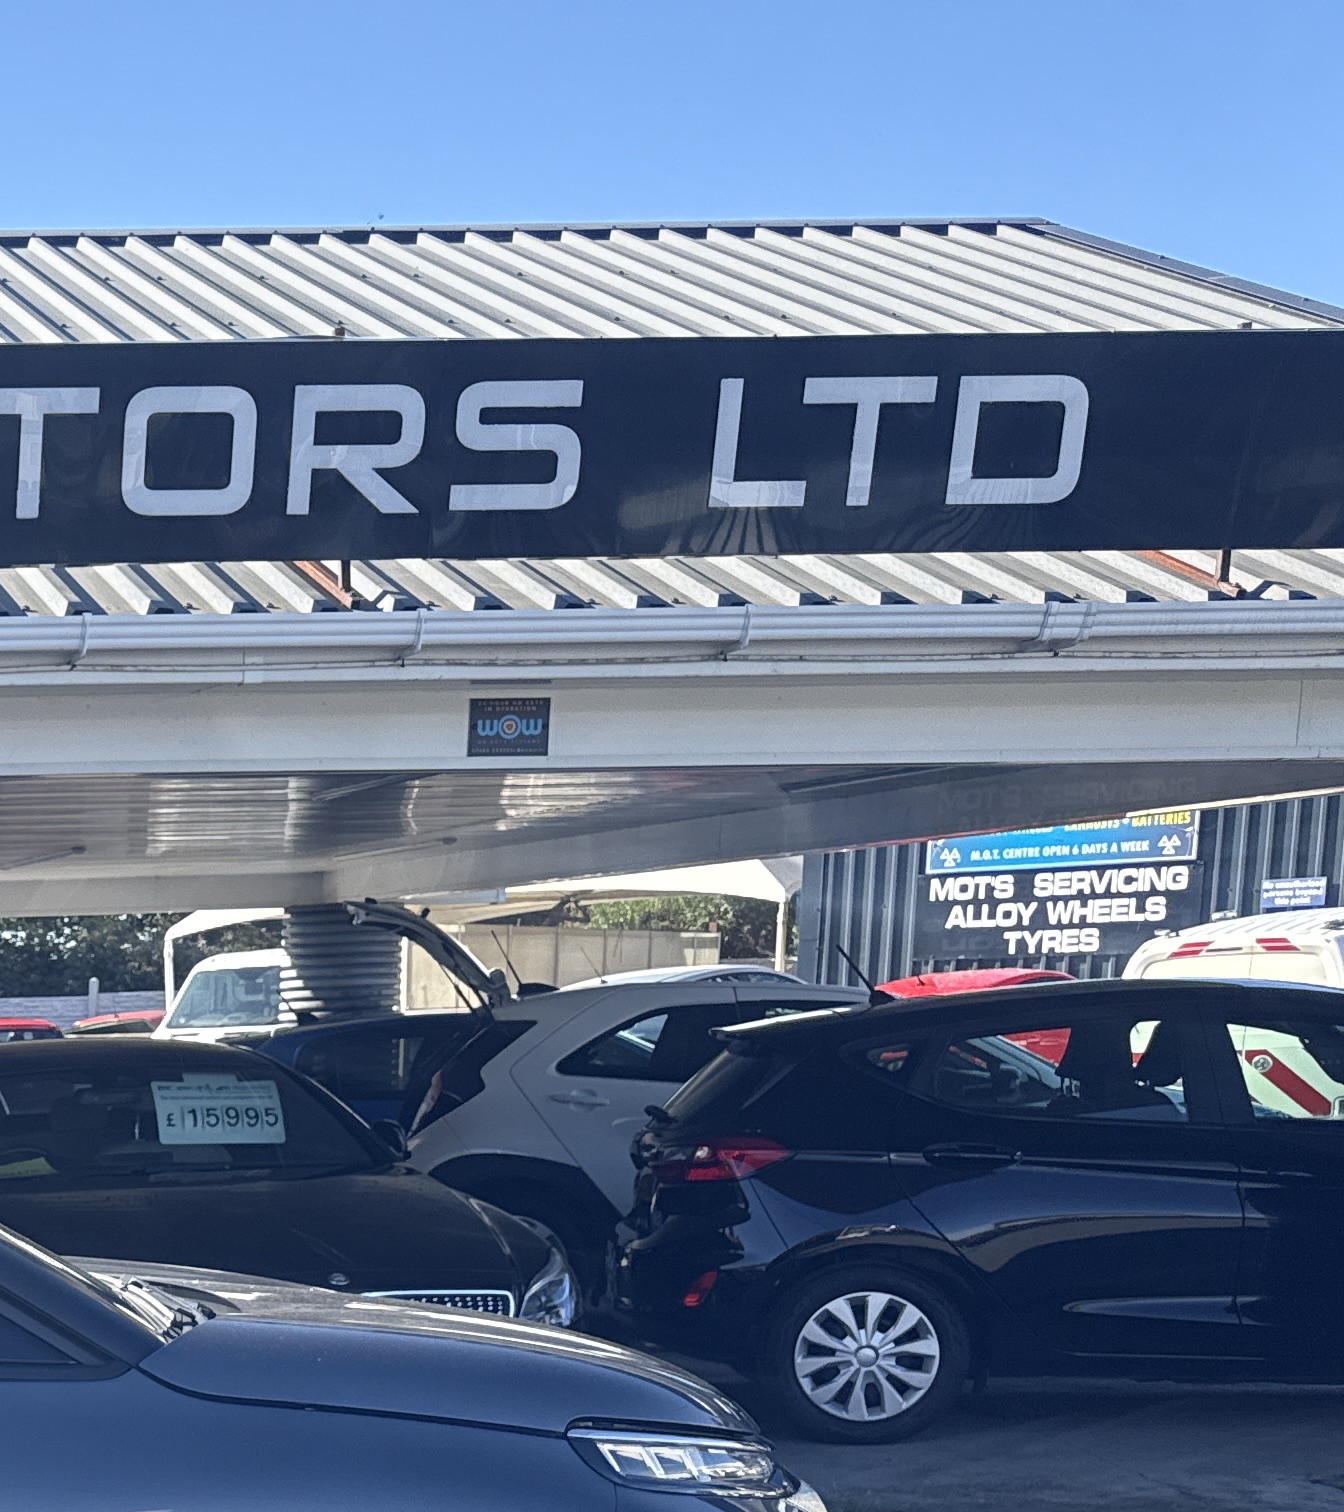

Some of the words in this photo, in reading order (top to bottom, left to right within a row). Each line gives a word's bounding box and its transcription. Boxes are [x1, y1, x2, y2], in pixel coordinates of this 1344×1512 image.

[708, 374, 1090, 508] LTD
[1002, 847, 1040, 860] CENTRE
[1042, 845, 1070, 857] OPEN
[1072, 844, 1079, 856] 6
[1081, 843, 1107, 855] DAYS
[1110, 842, 1119, 854] A
[1120, 840, 1150, 853] WEEK
[929, 875, 1015, 902] MOT'S
[1033, 865, 1190, 898] SERVICING
[944, 901, 1038, 929] ALLOY
[1046, 896, 1167, 925] WHEELS
[1003, 928, 1100, 954] TYRES
